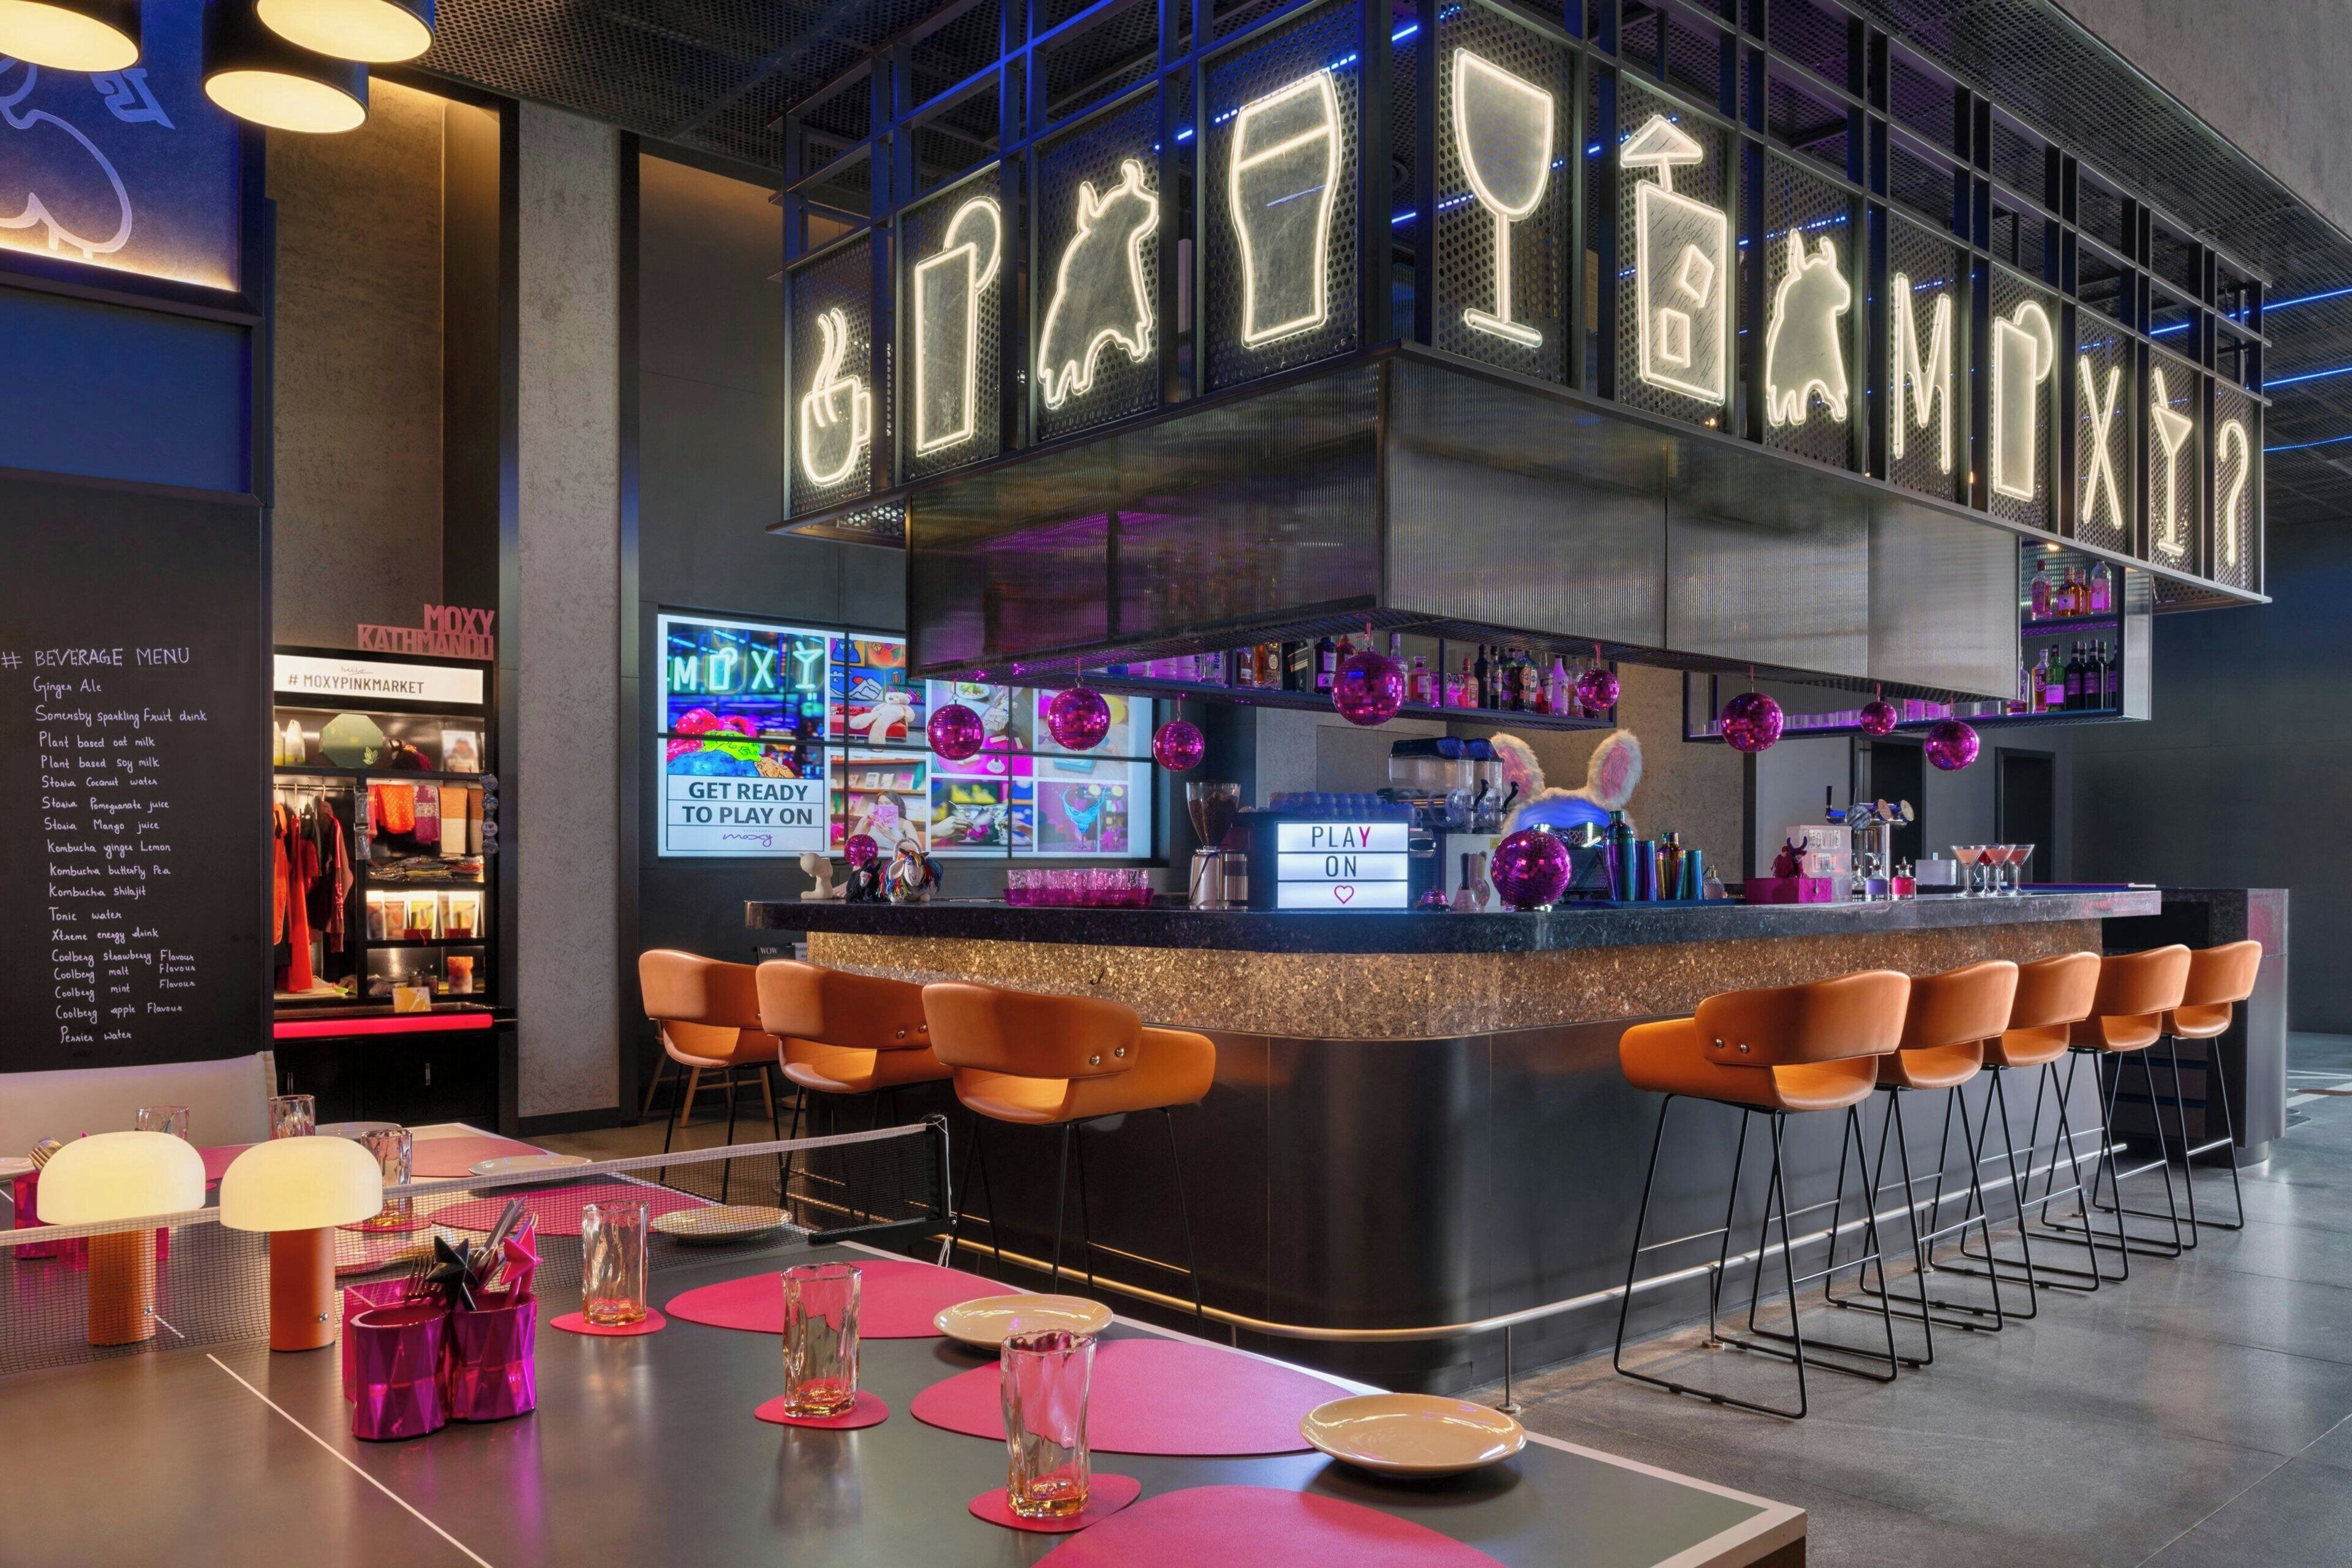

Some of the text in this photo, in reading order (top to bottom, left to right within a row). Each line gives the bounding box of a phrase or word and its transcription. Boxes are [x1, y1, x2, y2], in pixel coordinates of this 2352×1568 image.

[424, 604, 495, 638] MOXY
[358, 624, 494, 660] KATHMANDU
[1, 647, 189, 669] # BEVERAGE MENU
[33, 676, 102, 701] Ginger Ale
[303, 674, 424, 694] MOXYPINKMARKET
[35, 705, 92, 727] Somersby
[97, 710, 140, 729] sparkling
[179, 710, 208, 722] drink
[39, 731, 156, 748] Plant based oat milk
[40, 755, 160, 773] Plant based soy milk
[42, 775, 77, 788] Storia
[130, 777, 158, 786] water
[688, 782, 808, 801] GET READY
[42, 796, 170, 815] Storia Pomegranate juice
[682, 806, 813, 825] TO PLAY ON
[44, 817, 160, 835] Storia Mango juice
[140, 840, 172, 852] Lemon
[1311, 826, 1371, 848] PLAY
[153, 864, 172, 875] Pea
[1325, 856, 1357, 878] ON
[48, 907, 123, 921] Tonic water
[51, 926, 159, 944] Xtreme energy drink
[51, 949, 94, 967] Coolberg
[160, 949, 195, 962] Flavour
[54, 963, 196, 984] Coolberg malt Flavour
[55, 979, 196, 1003] Coolberg mint Flavour
[56, 1002, 183, 1024] Coolberg apple Flavour
[61, 1025, 132, 1044] Perrier water
